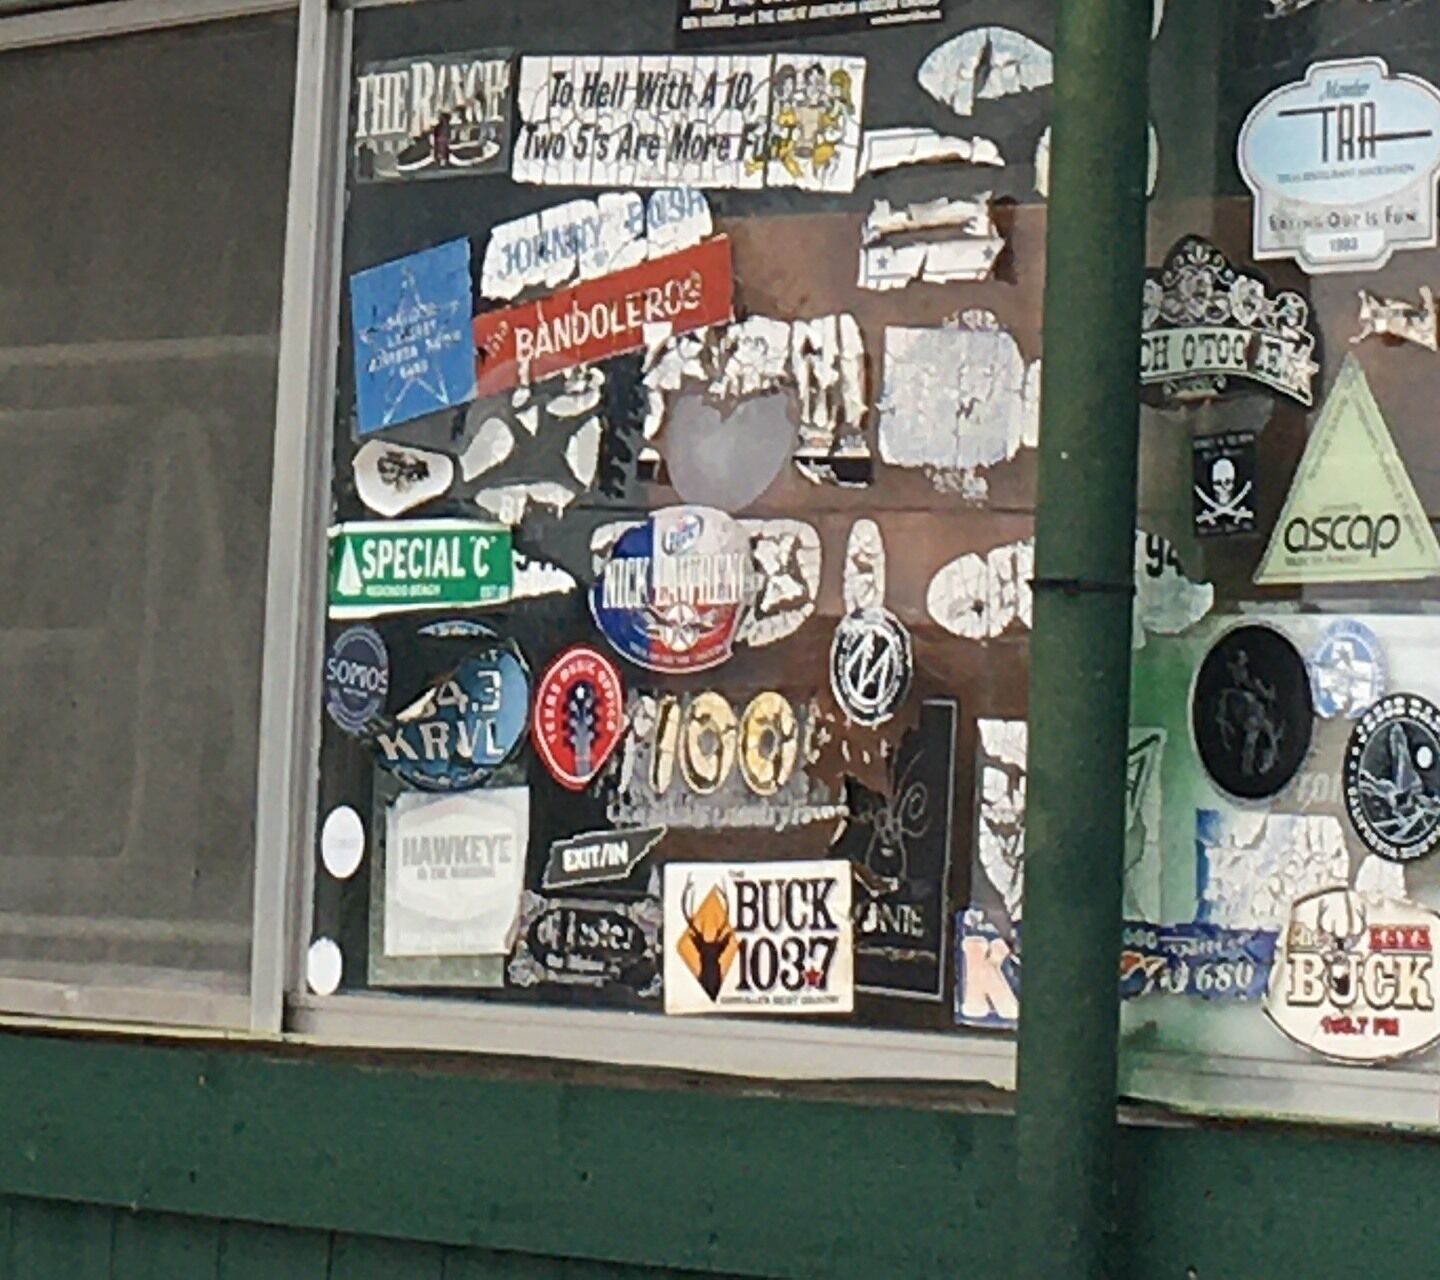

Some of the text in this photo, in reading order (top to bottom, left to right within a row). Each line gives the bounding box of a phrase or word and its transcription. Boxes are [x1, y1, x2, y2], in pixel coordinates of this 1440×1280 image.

[356, 71, 409, 138] THE
[549, 70, 574, 108] To
[579, 70, 629, 108] Hell
[636, 68, 695, 110] With
[699, 68, 718, 108] A
[523, 123, 565, 161] Two
[616, 124, 660, 161] Are
[667, 124, 730, 161] More
[1277, 101, 1433, 163] TRA
[514, 272, 702, 363] BANDOLEROS
[362, 535, 497, 580] SPECIAL "C"
[1284, 512, 1400, 558] ascap
[602, 557, 650, 609] NICK
[376, 719, 506, 762] KRVL
[402, 835, 513, 867] HAWKEYE
[563, 841, 630, 873] EXIT/IN
[734, 878, 839, 933] BUCK
[1287, 951, 1434, 1012] BUCK
